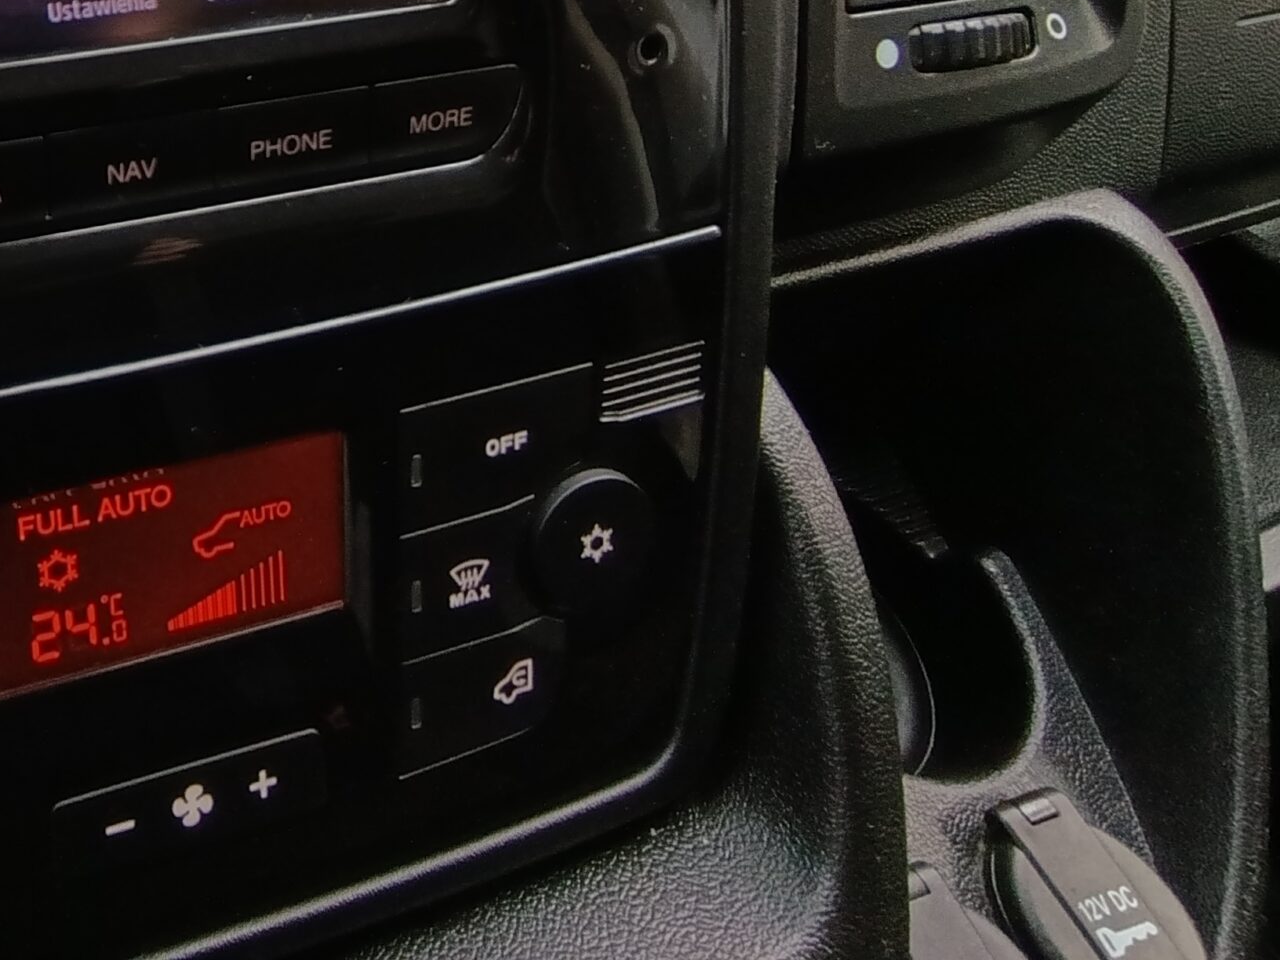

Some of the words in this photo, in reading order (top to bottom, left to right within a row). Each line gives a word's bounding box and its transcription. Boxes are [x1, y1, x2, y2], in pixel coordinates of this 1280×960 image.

[409, 105, 474, 135] MORE
[250, 128, 334, 160] PHONE
[107, 157, 158, 185] NAV
[485, 430, 528, 457] OFF
[18, 504, 91, 541] FULL
[97, 484, 172, 523] AUTO
[239, 500, 292, 528] AUTO
[449, 585, 491, 609] MAX
[1078, 895, 1111, 923] 12V
[1107, 885, 1139, 913] DC
